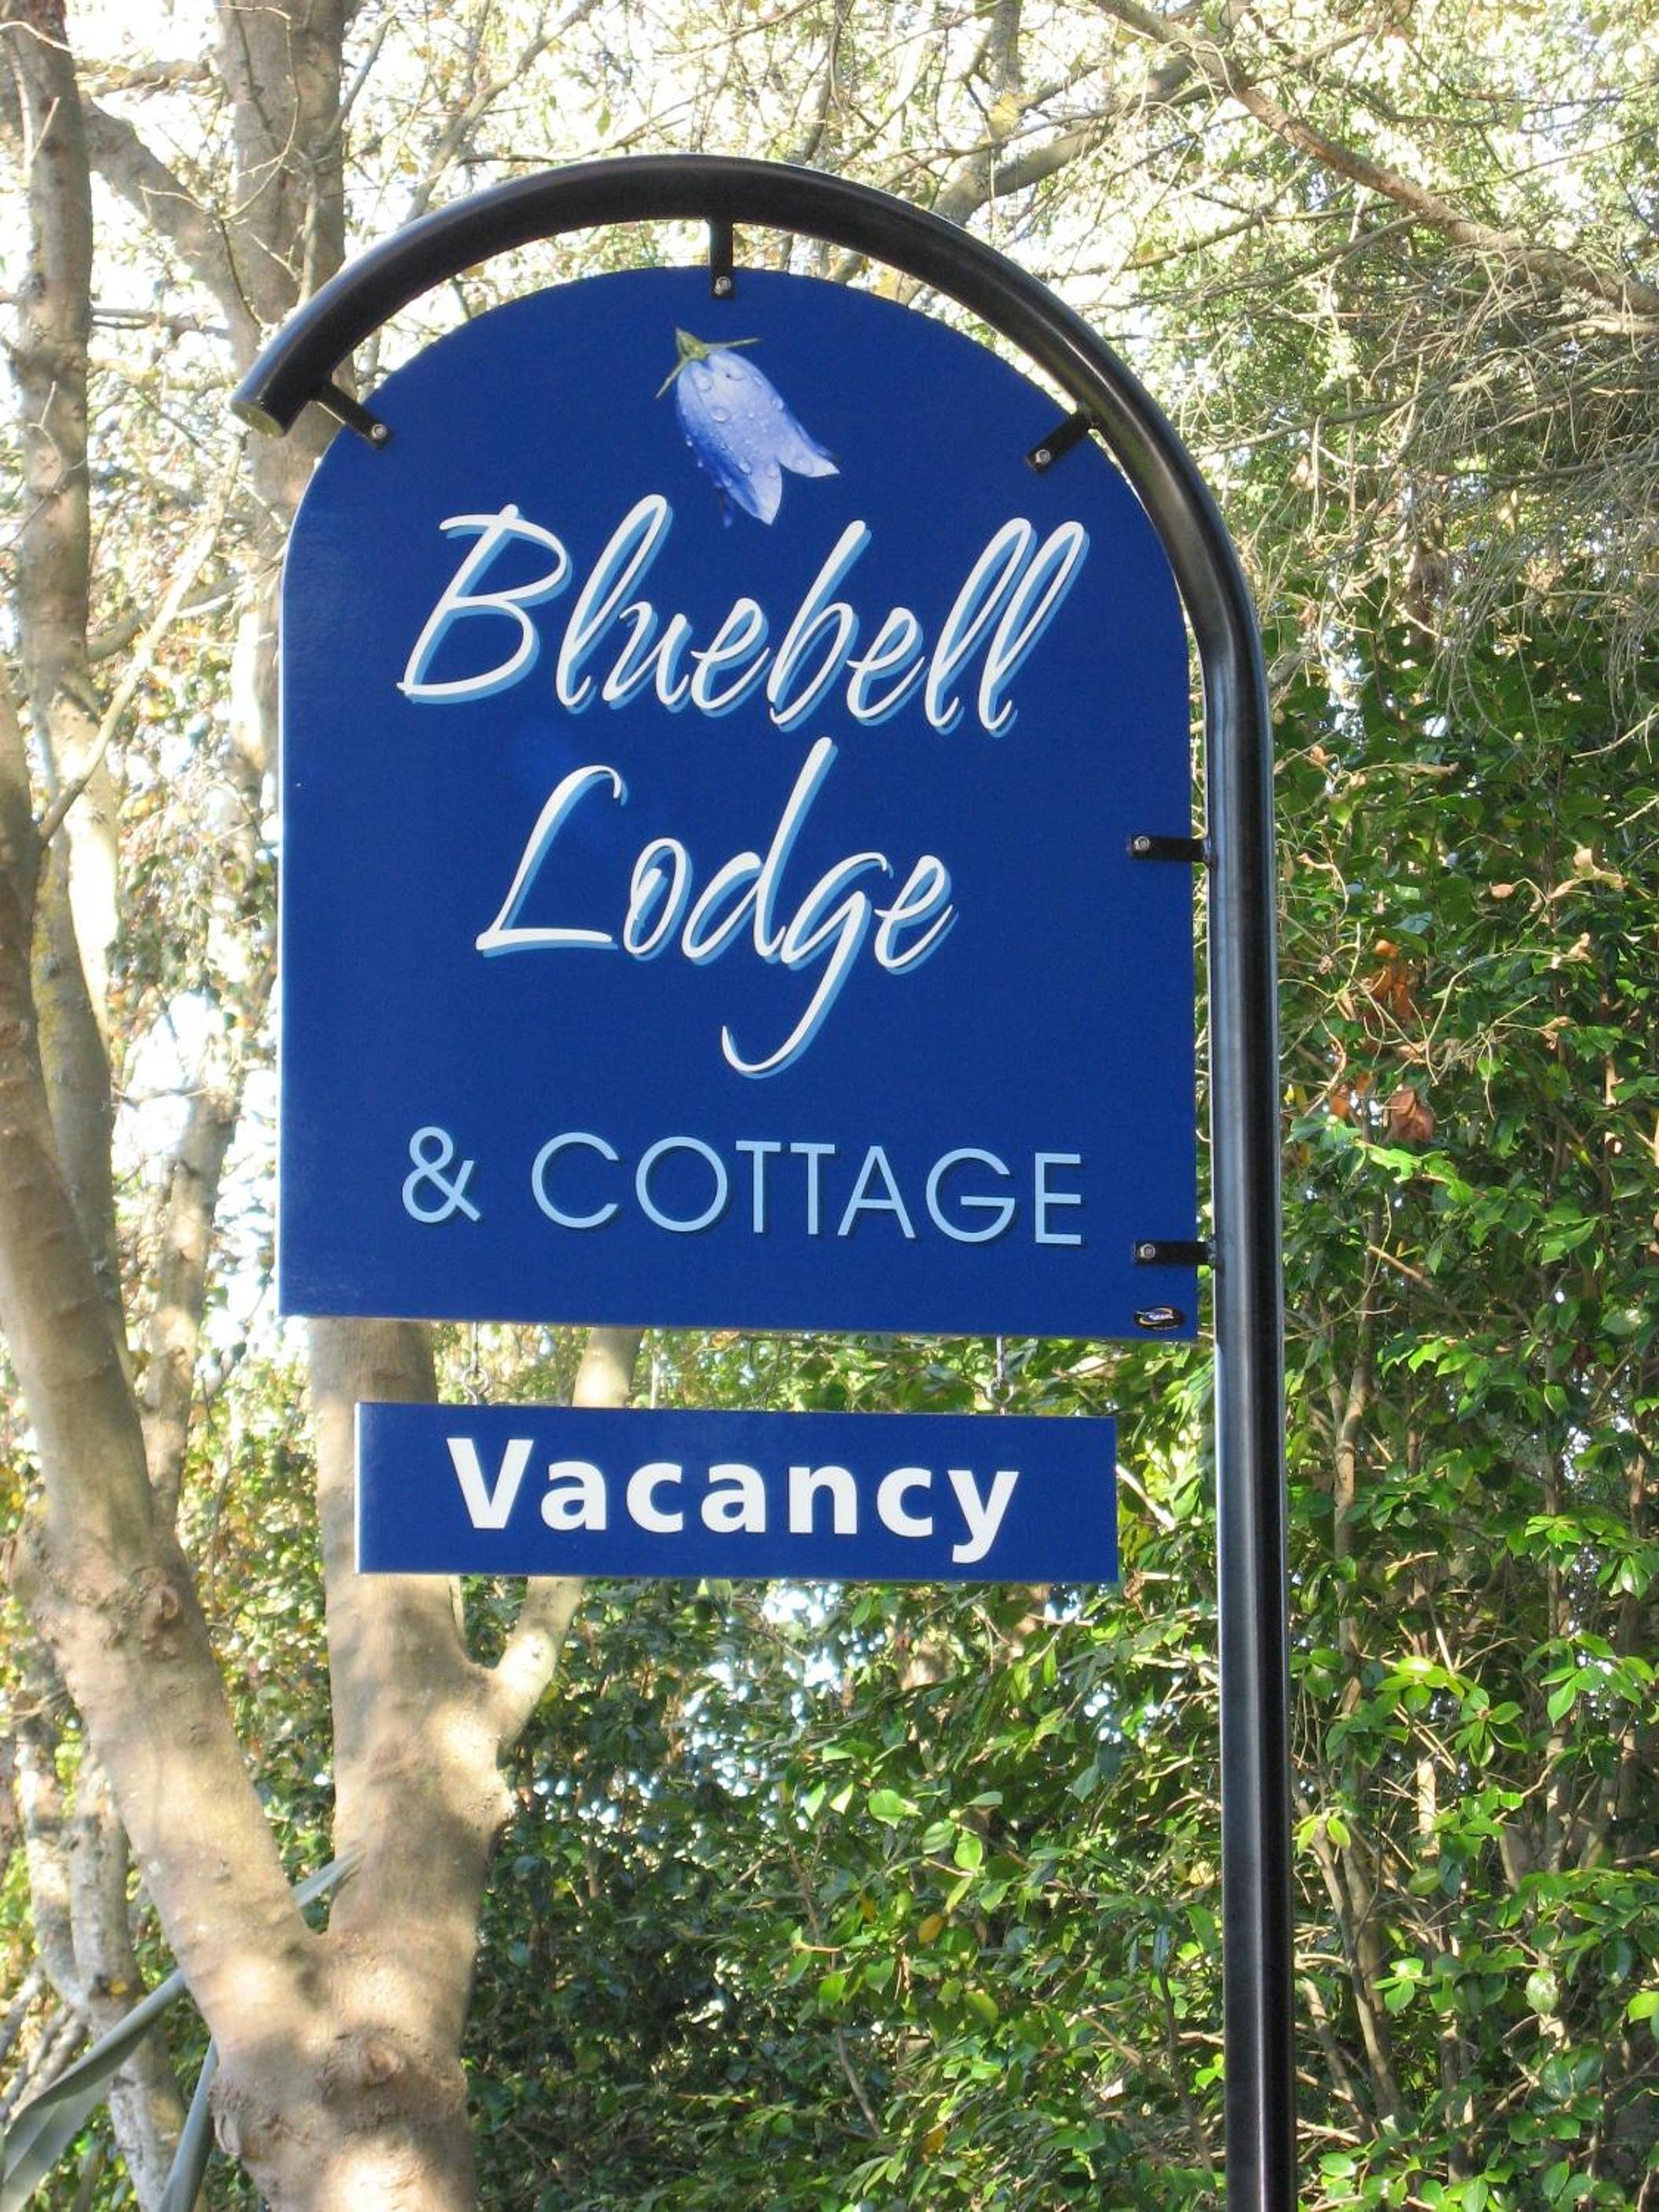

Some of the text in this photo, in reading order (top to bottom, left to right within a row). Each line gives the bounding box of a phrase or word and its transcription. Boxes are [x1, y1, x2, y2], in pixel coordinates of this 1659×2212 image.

[397, 493, 1090, 738] Bluebell
[475, 736, 957, 1081] Lodge
[401, 1126, 1085, 1249] & COTTAGE
[446, 1437, 1020, 1565] Vacancy
